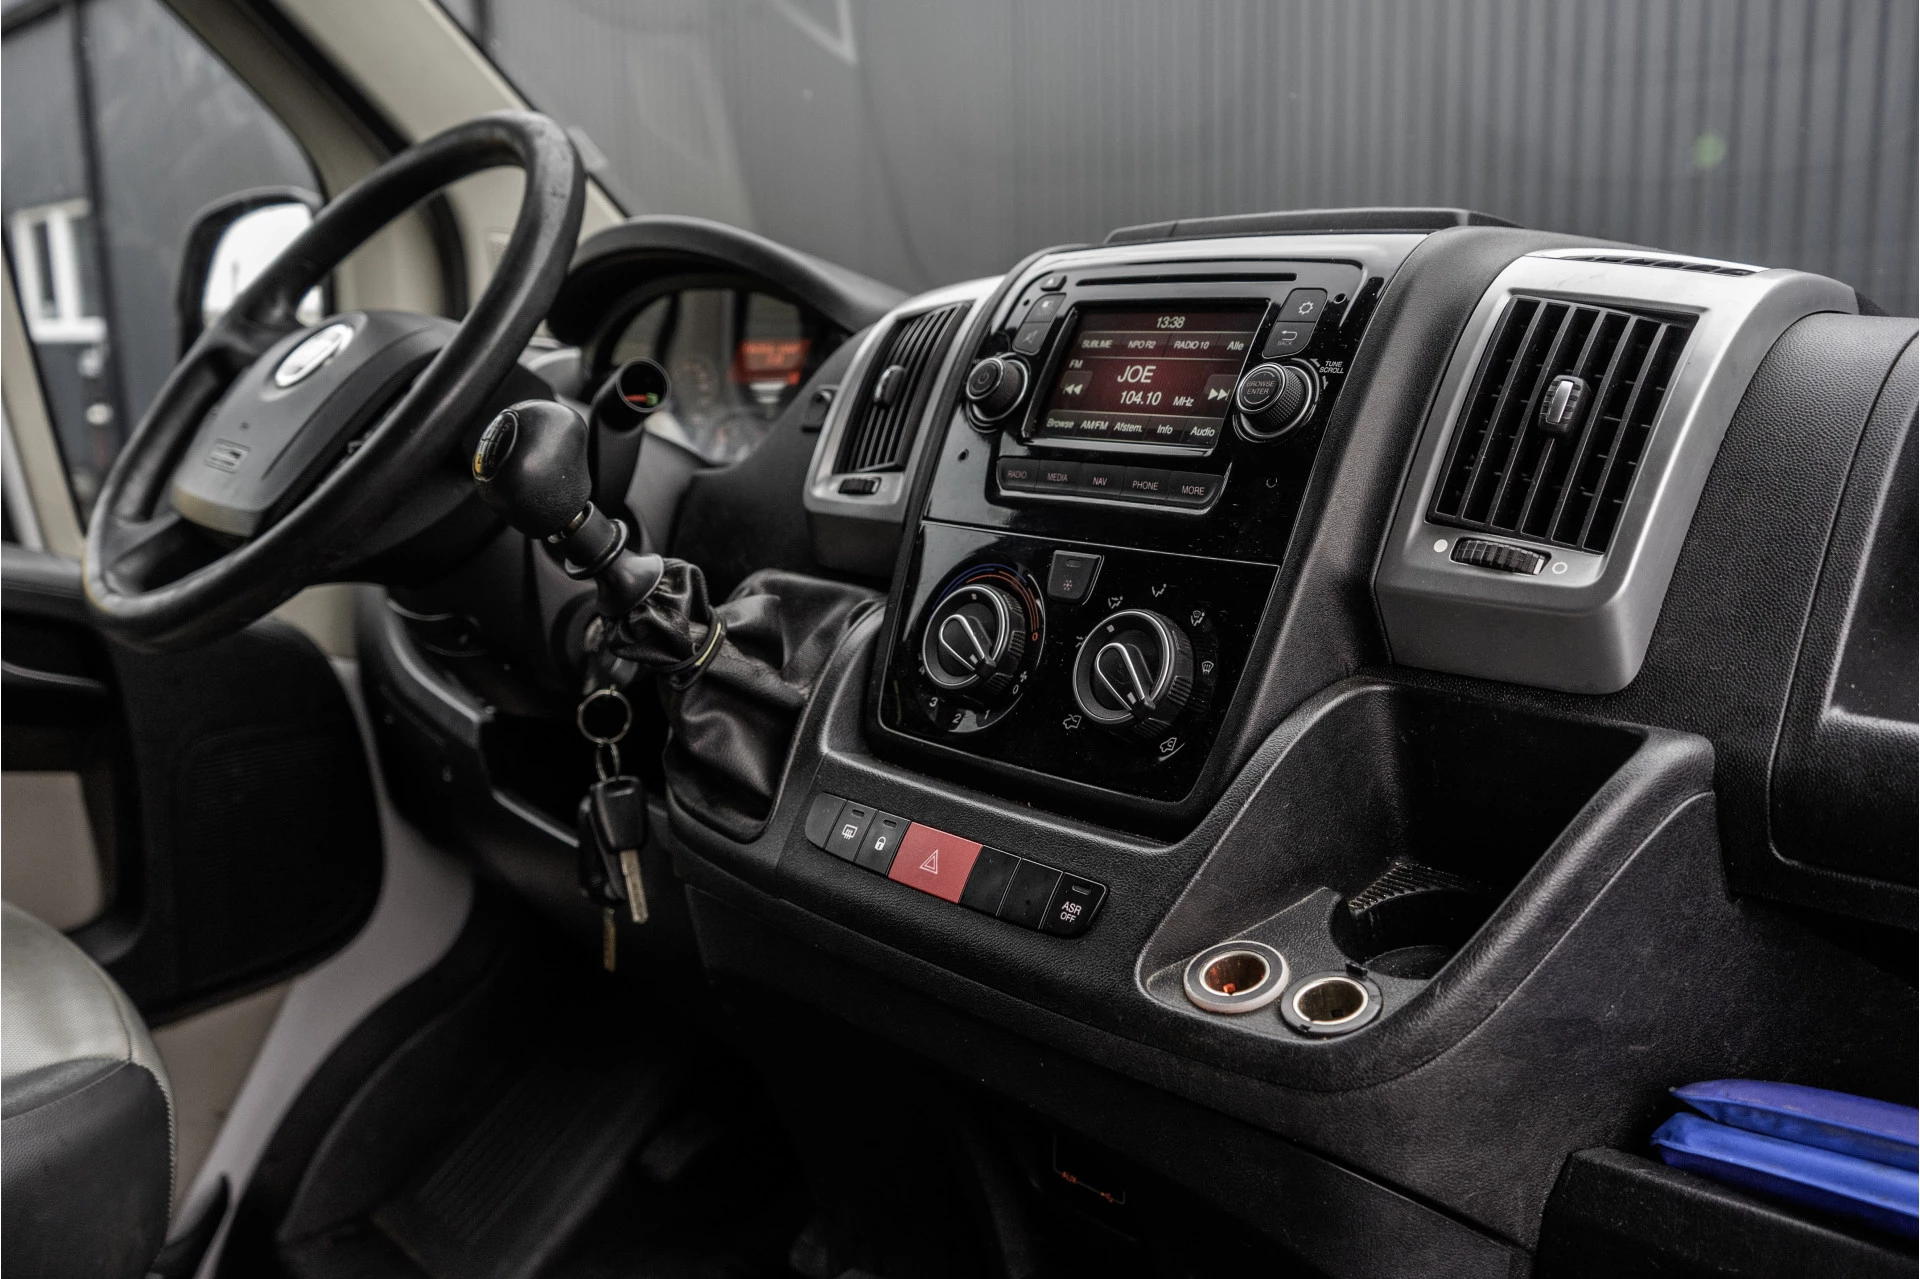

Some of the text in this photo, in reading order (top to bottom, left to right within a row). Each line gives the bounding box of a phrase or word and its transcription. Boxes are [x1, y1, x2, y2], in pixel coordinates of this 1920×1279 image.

[1156, 316, 1185, 328] 13:38
[1128, 340, 1157, 349] NPO R2
[1174, 341, 1210, 350] RADIO 10
[1226, 341, 1244, 350] Alle
[1069, 359, 1084, 368] FM
[1117, 365, 1156, 383] JOE
[1319, 366, 1344, 374] SCROLL
[1246, 380, 1275, 388] BROWSE
[1120, 390, 1194, 407] 104.10 MHz
[1046, 418, 1075, 429] Browse
[1157, 424, 1173, 435] Info
[1190, 426, 1216, 437] Audio
[1007, 470, 1028, 479] RADIO
[1047, 472, 1068, 482] MEDIA
[1092, 476, 1107, 486] NAV
[1132, 480, 1159, 491] PHONE
[1181, 485, 1205, 496] MORE
[929, 697, 938, 707] 3
[952, 713, 962, 724] 2
[1061, 901, 1082, 915] ASR
[1060, 911, 1076, 922] OFF
